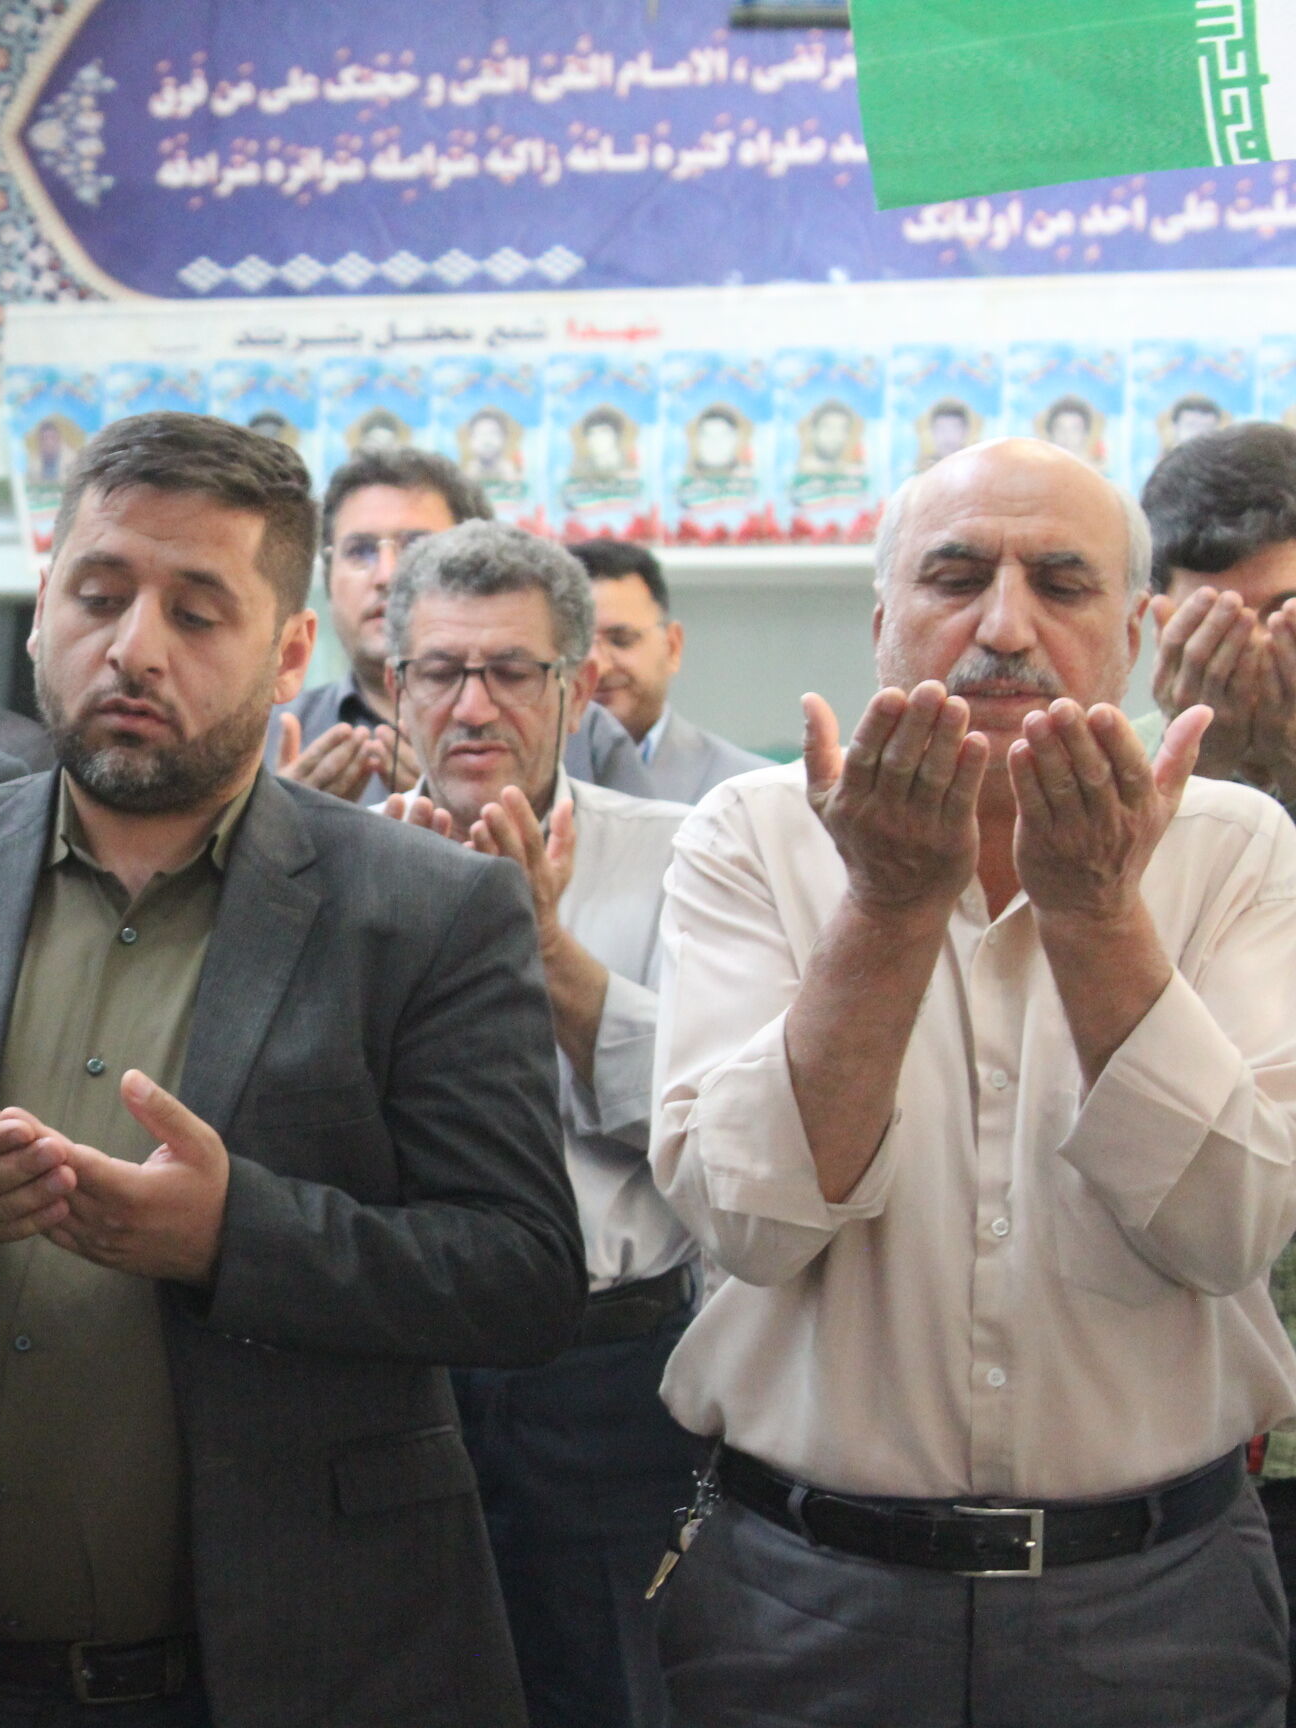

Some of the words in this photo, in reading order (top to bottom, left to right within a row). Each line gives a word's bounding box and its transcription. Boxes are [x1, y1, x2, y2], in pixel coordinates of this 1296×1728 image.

[257, 65, 320, 115] علی
[1026, 208, 1075, 248] من
[1150, 190, 1220, 244] علی
